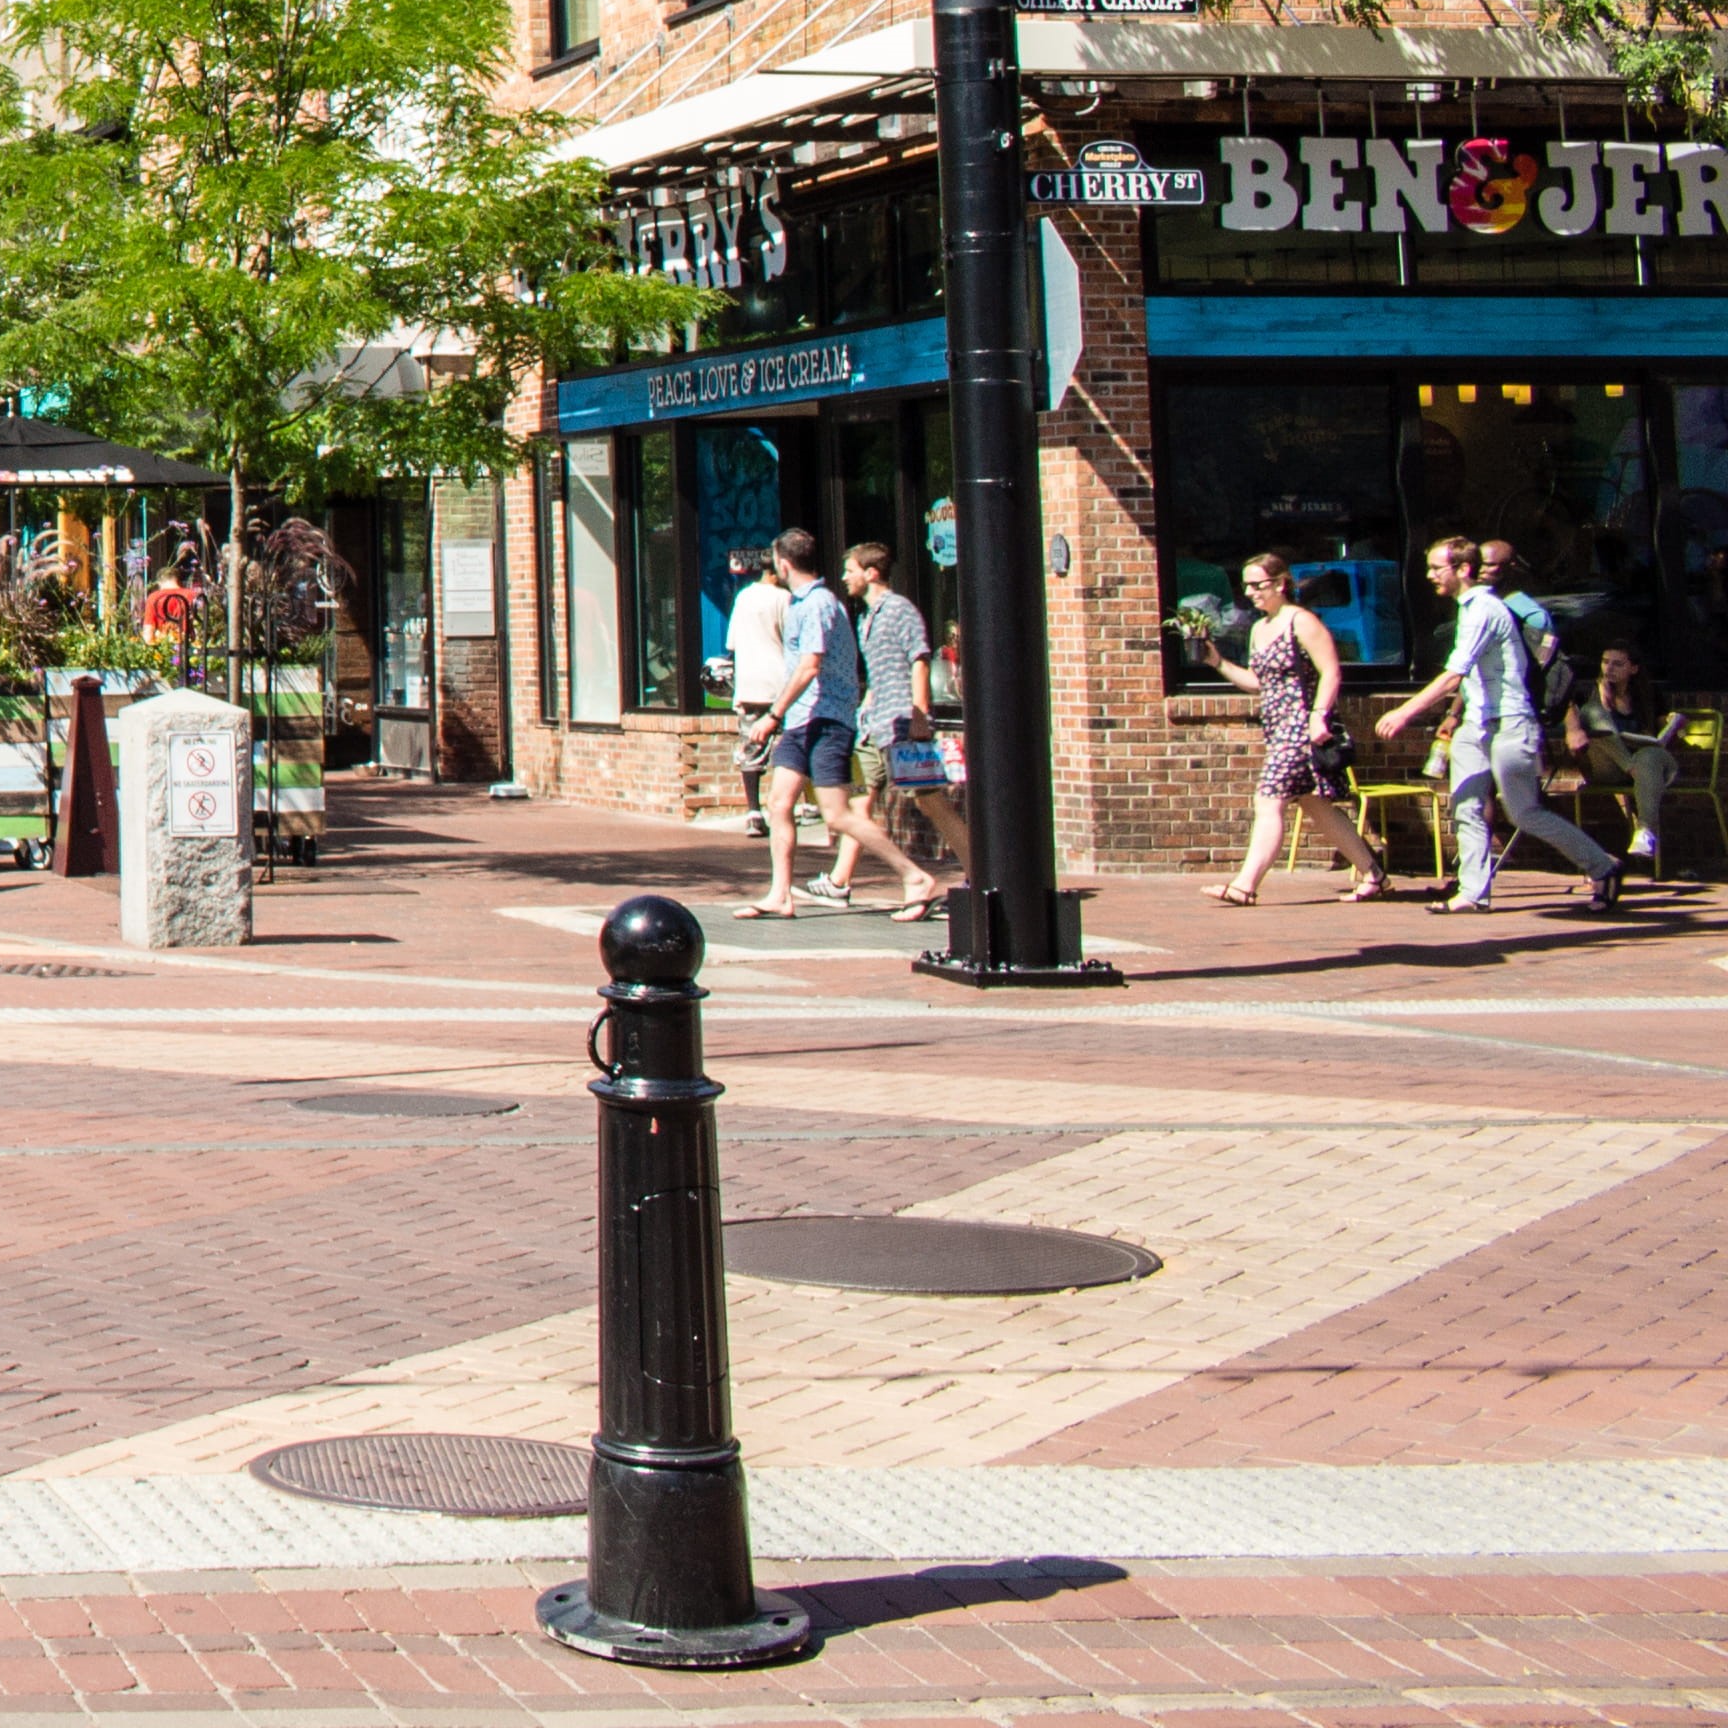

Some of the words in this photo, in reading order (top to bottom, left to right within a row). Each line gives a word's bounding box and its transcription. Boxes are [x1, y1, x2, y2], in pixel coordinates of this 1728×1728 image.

[1084, 152, 1137, 162] Marketplace
[1030, 172, 1170, 201] CHERRY
[1174, 173, 1197, 189] ST
[1219, 135, 1449, 234] BEN
[1449, 137, 1538, 235] &
[647, 370, 697, 408] PEACE,
[699, 363, 738, 401] LOVE
[741, 358, 756, 394] &
[760, 355, 786, 393] ICE
